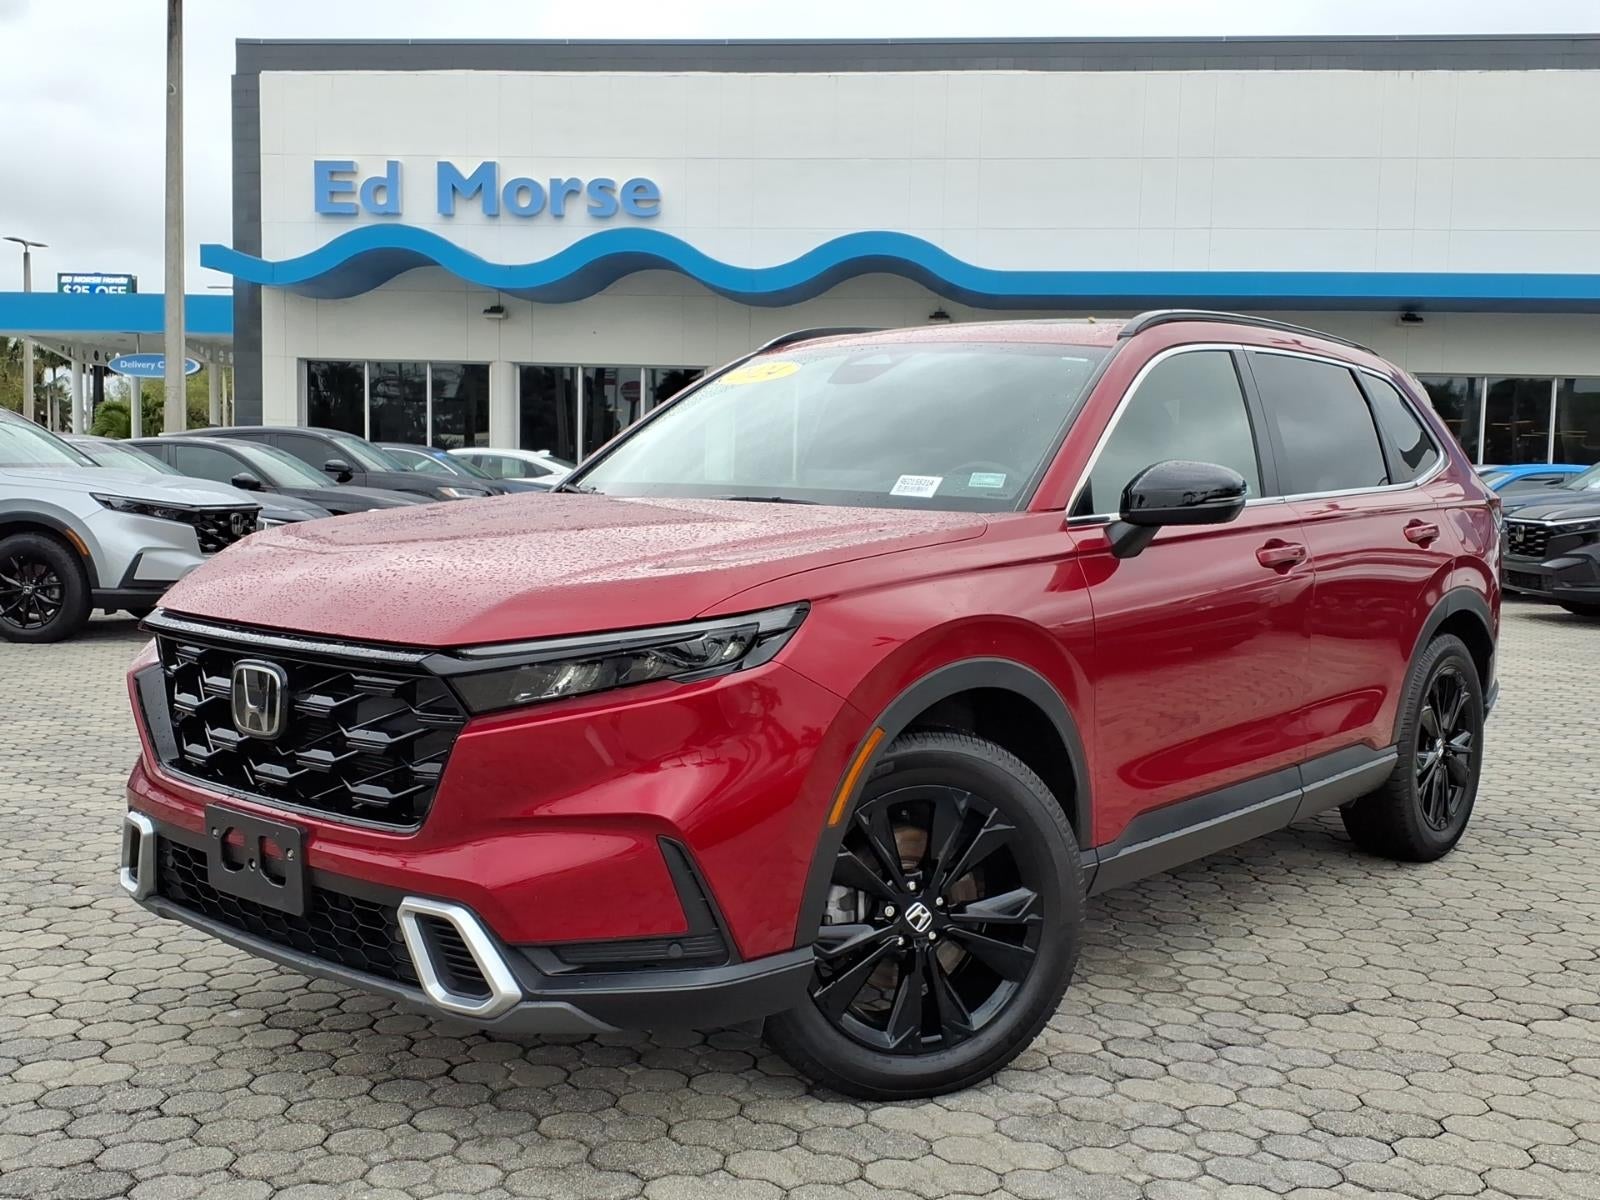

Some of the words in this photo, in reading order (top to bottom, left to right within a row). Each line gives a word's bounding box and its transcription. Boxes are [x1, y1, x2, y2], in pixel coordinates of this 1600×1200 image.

[313, 160, 402, 216] Ed
[437, 160, 662, 218] Morse
[120, 360, 155, 371] Delivery
